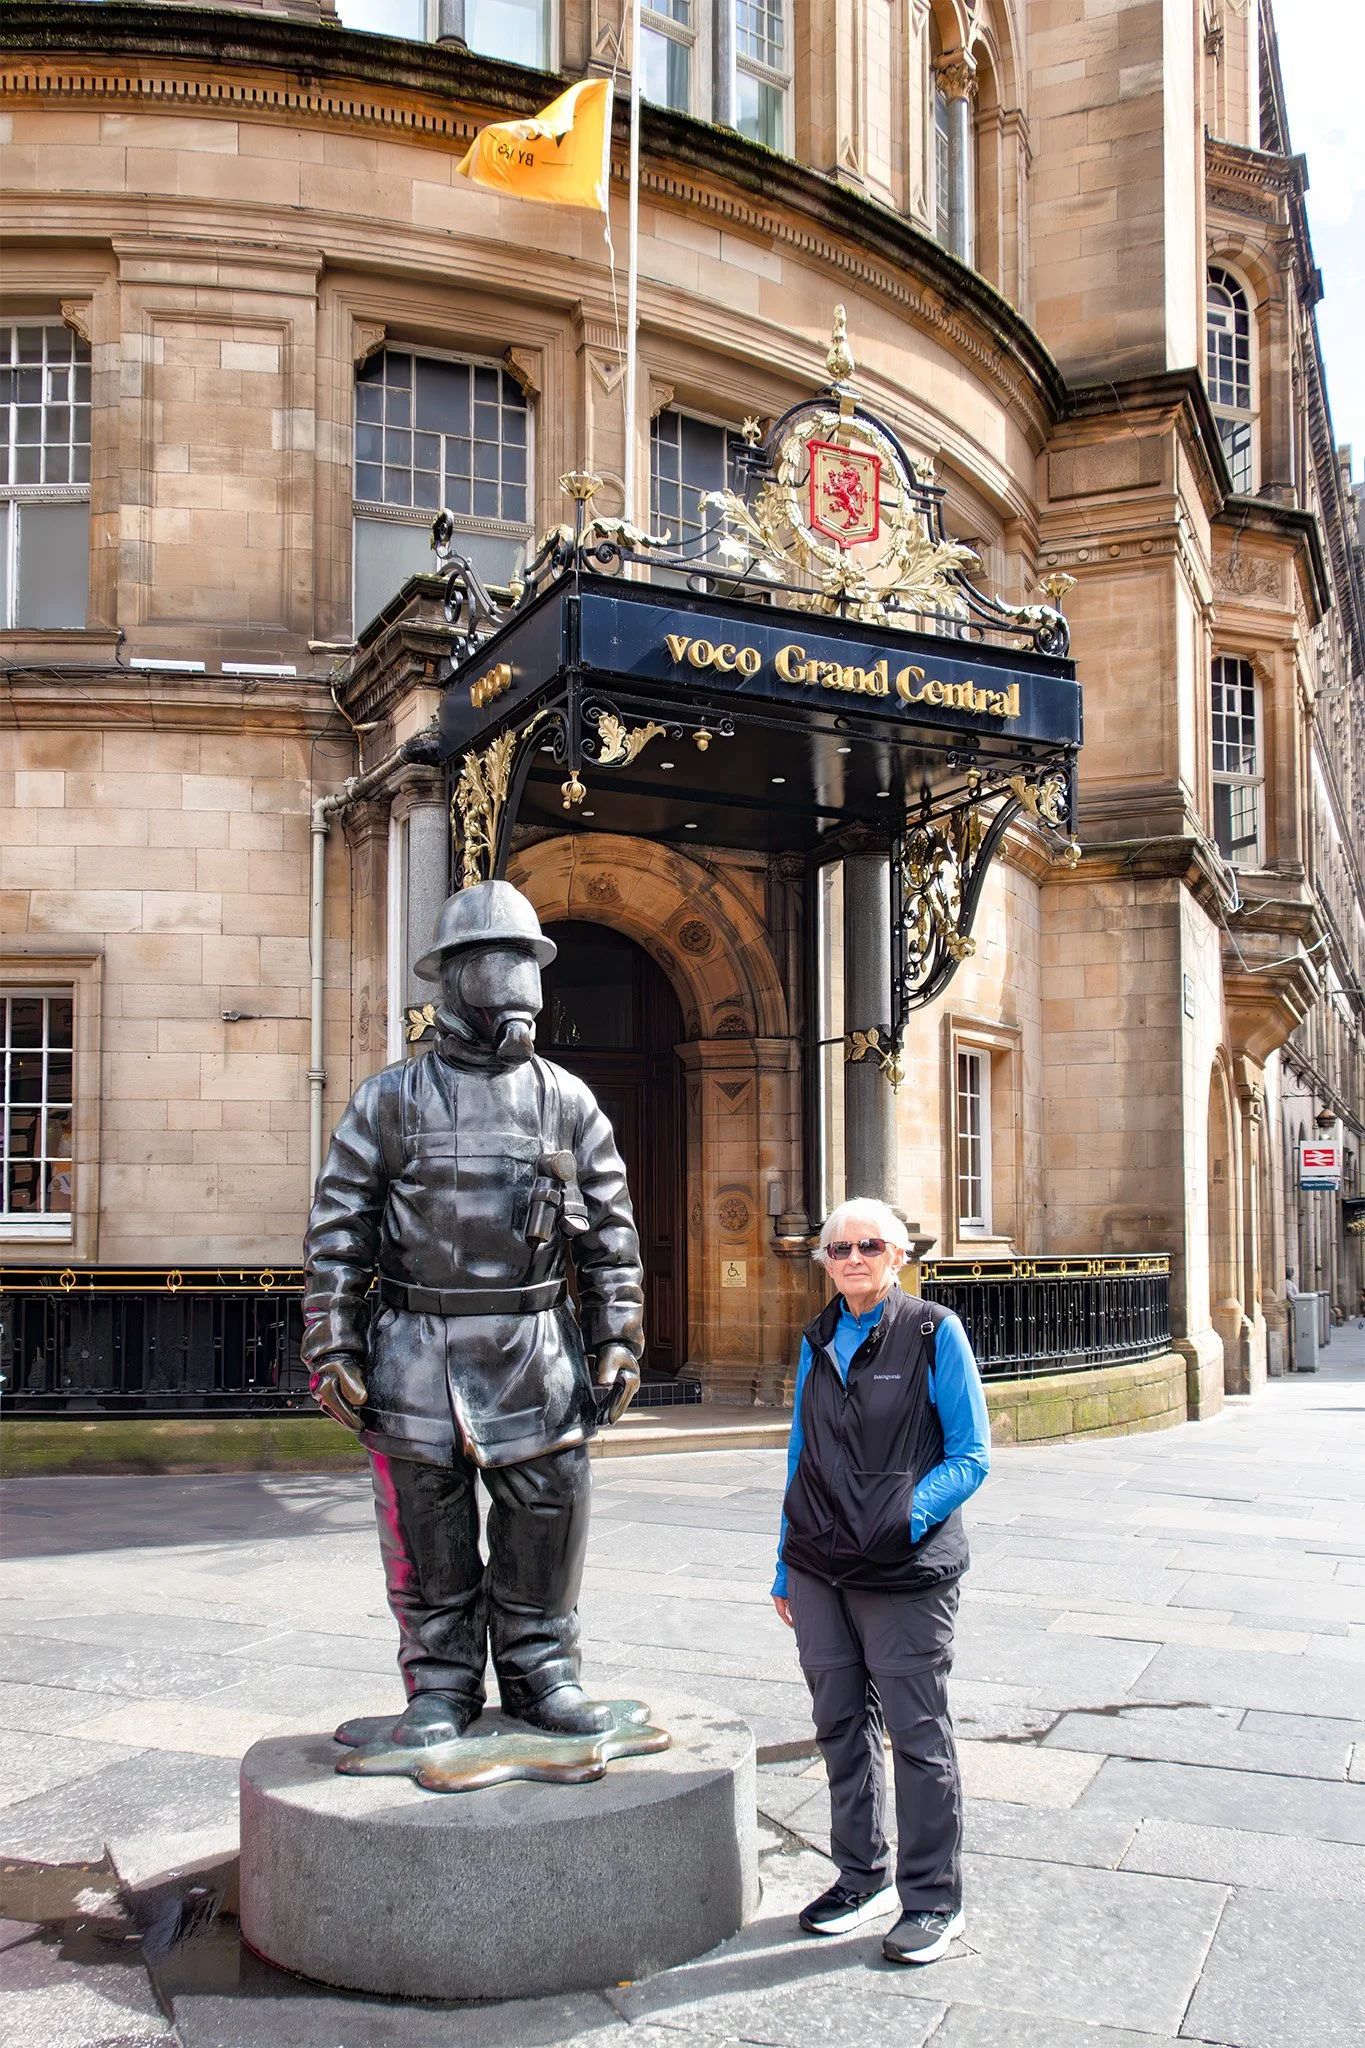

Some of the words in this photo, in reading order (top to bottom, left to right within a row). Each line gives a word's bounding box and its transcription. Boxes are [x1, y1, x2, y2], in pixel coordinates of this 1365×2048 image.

[663, 633, 762, 677] voco
[775, 644, 890, 697] Grand
[895, 665, 1021, 719] Central
